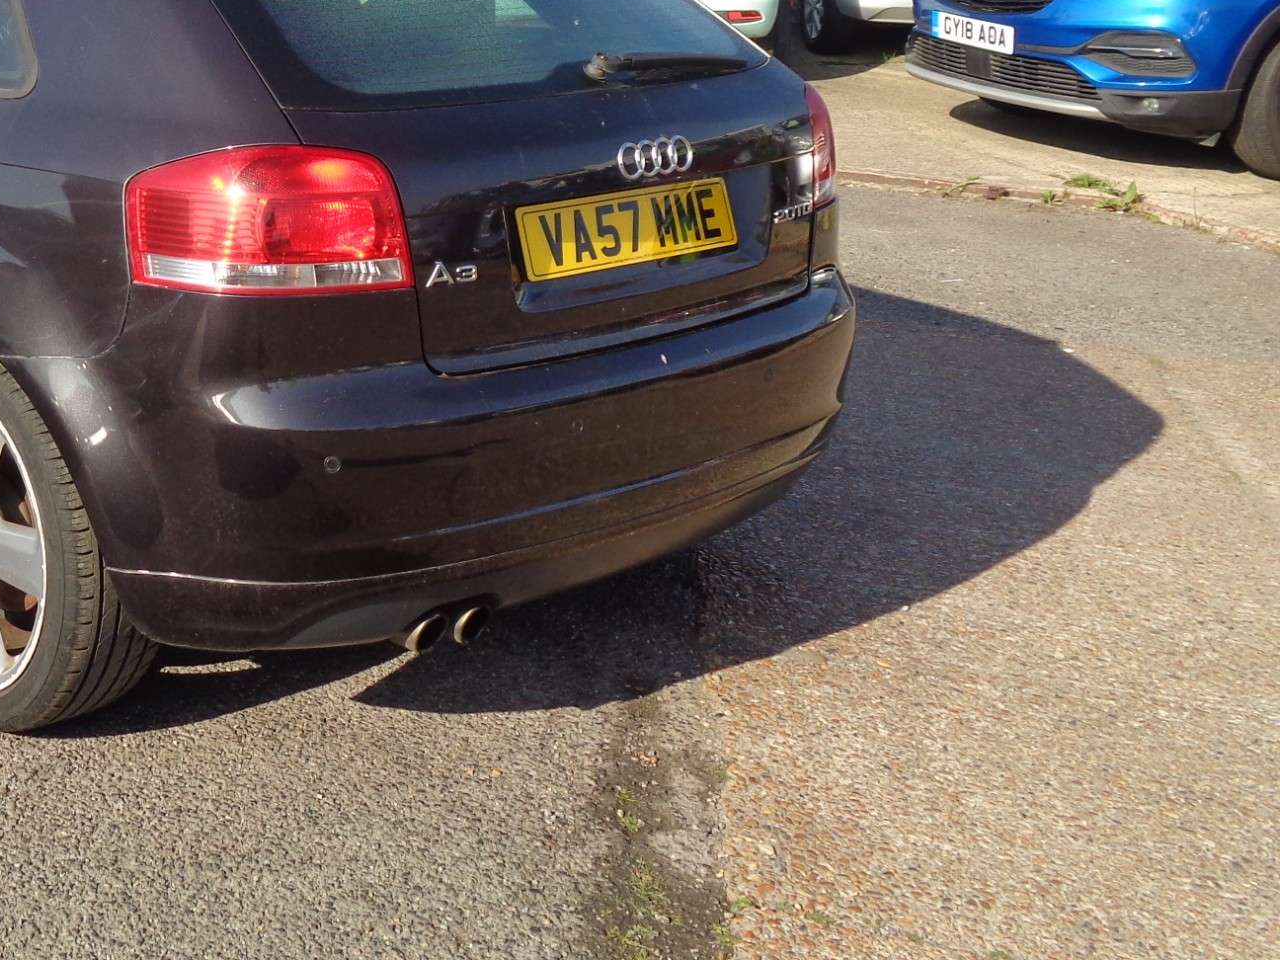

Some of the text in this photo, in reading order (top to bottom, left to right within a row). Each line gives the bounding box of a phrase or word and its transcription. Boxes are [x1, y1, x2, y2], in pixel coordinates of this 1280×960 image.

[944, 16, 1006, 48] GY18 AOA
[538, 188, 722, 267] VA57 MME
[425, 261, 478, 288] A3
